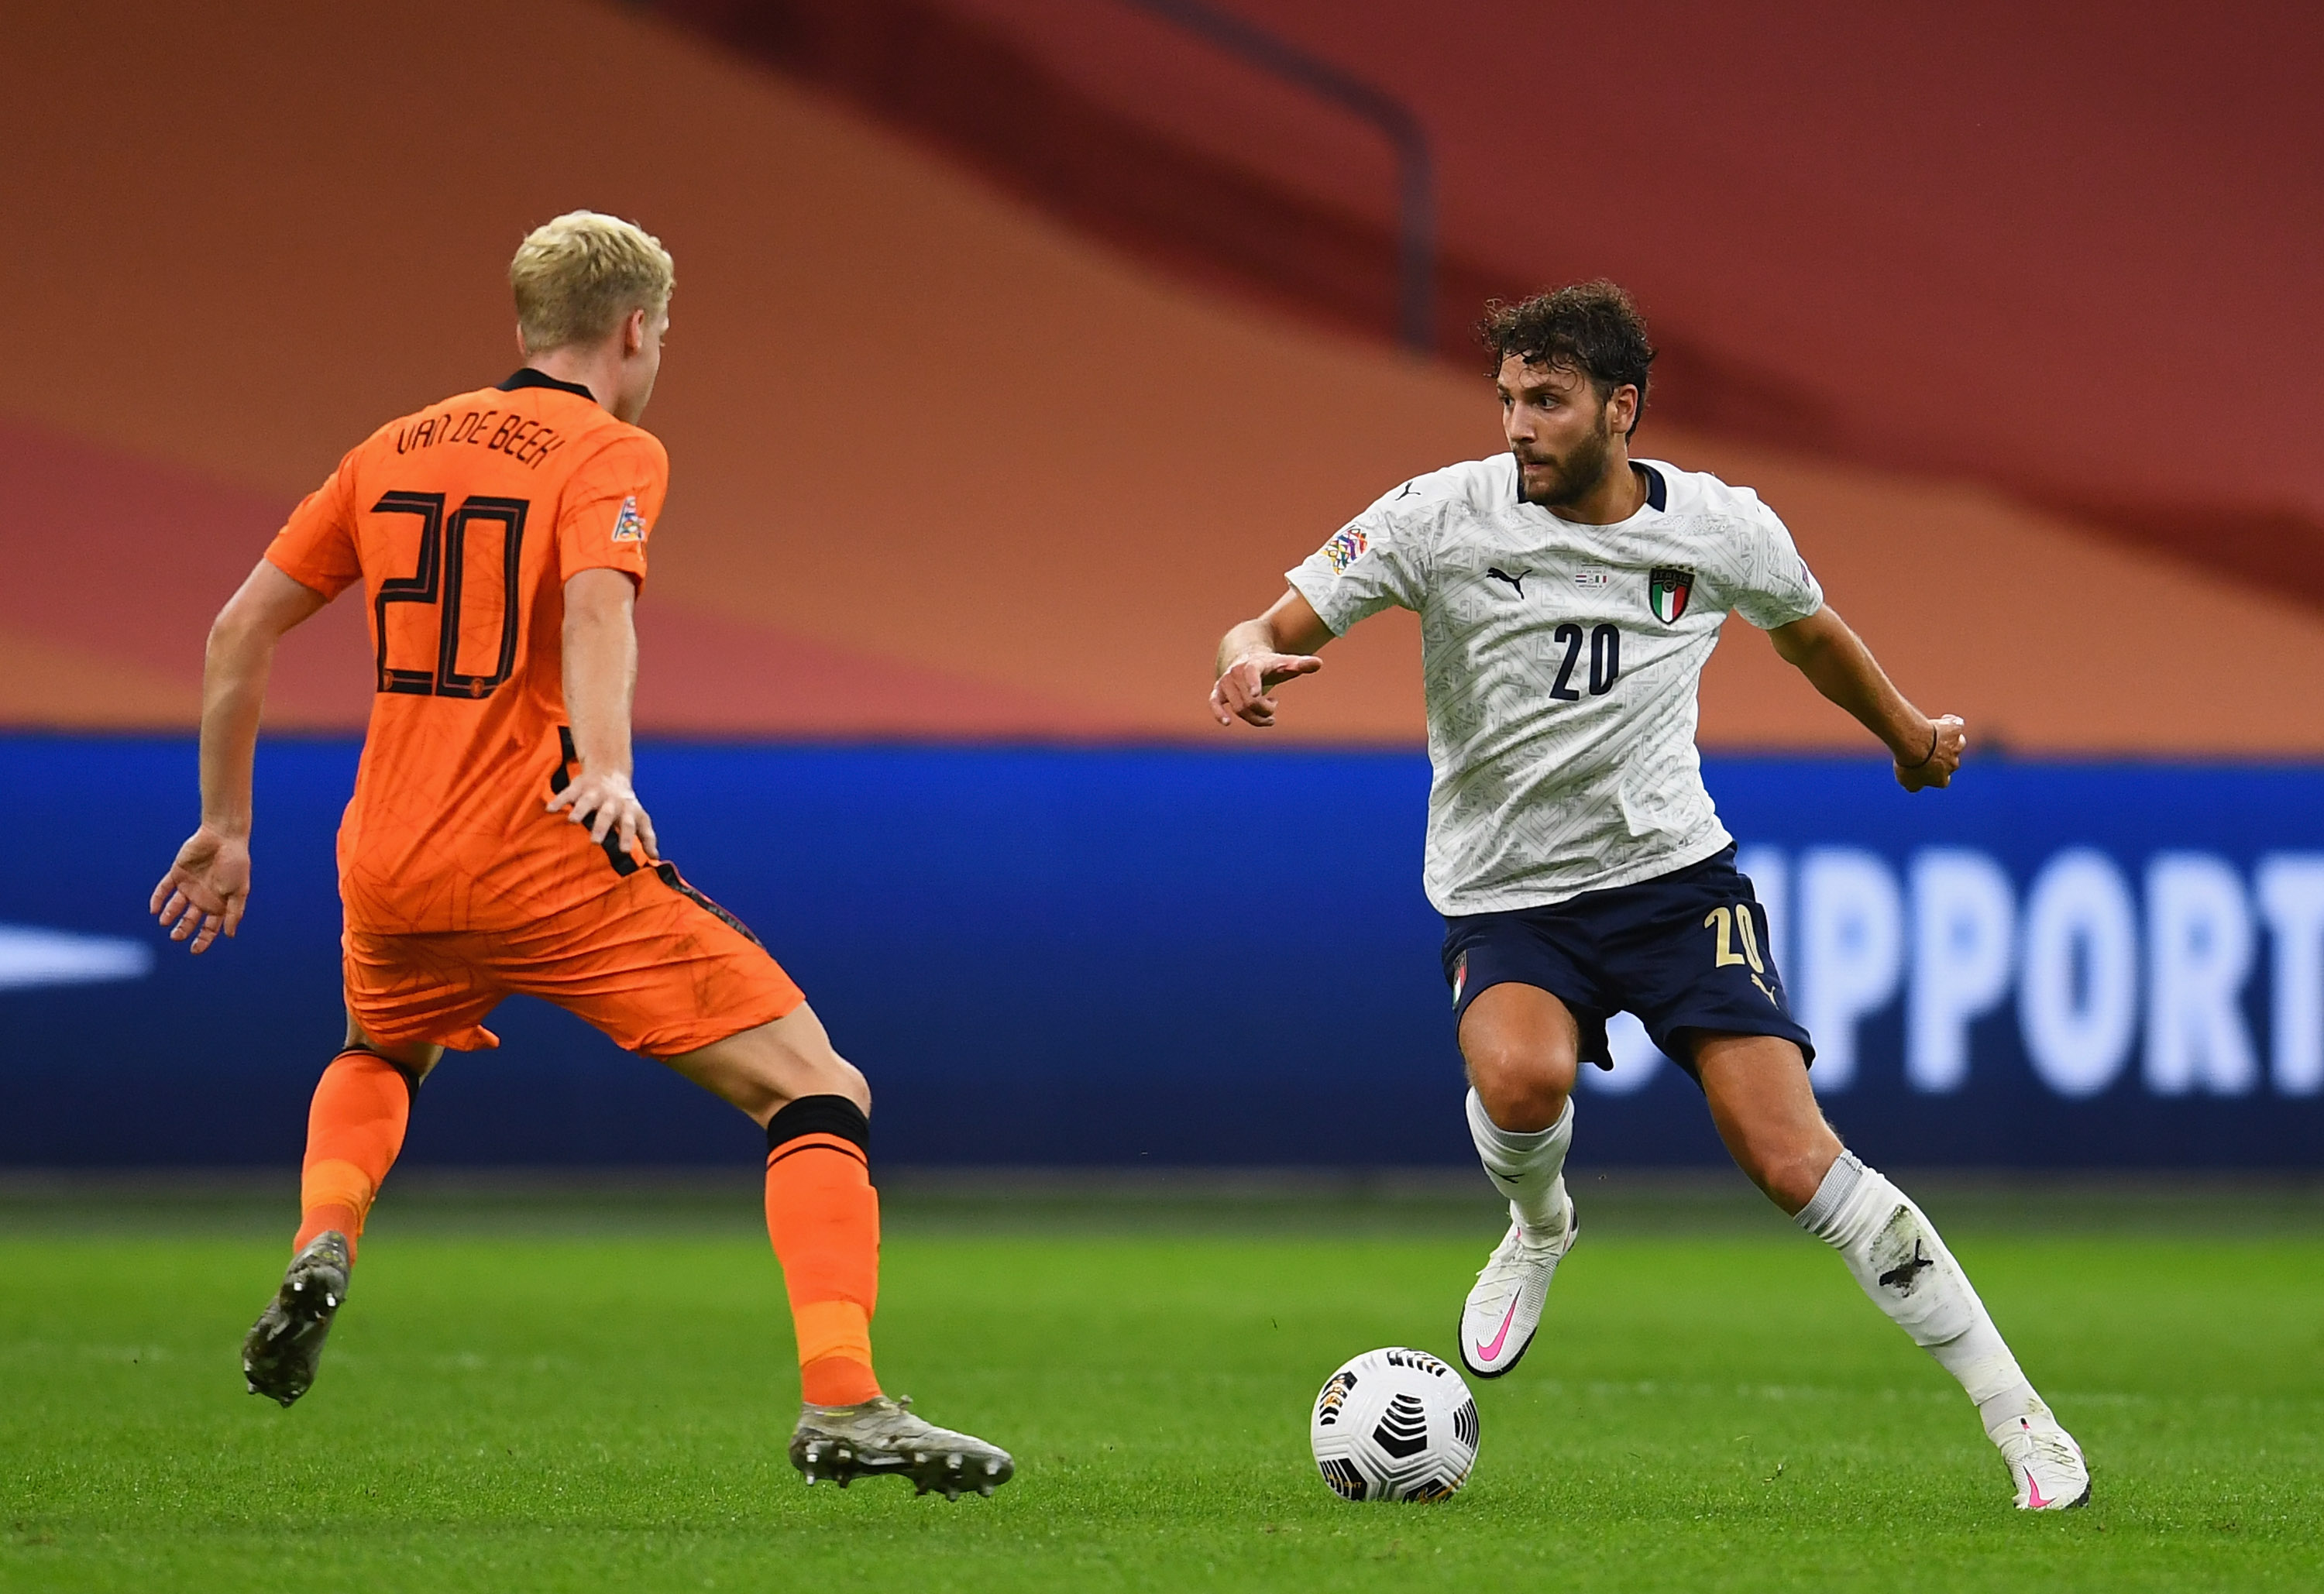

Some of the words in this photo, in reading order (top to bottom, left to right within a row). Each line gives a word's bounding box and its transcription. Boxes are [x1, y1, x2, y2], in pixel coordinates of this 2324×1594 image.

[397, 414, 451, 455] VAN
[449, 411, 497, 444] DE
[487, 414, 566, 470] BEEK
[370, 490, 530, 699] 20
[1653, 571, 1690, 582] ITALIA
[1549, 623, 1620, 702] 20
[1704, 904, 1764, 974] 20
